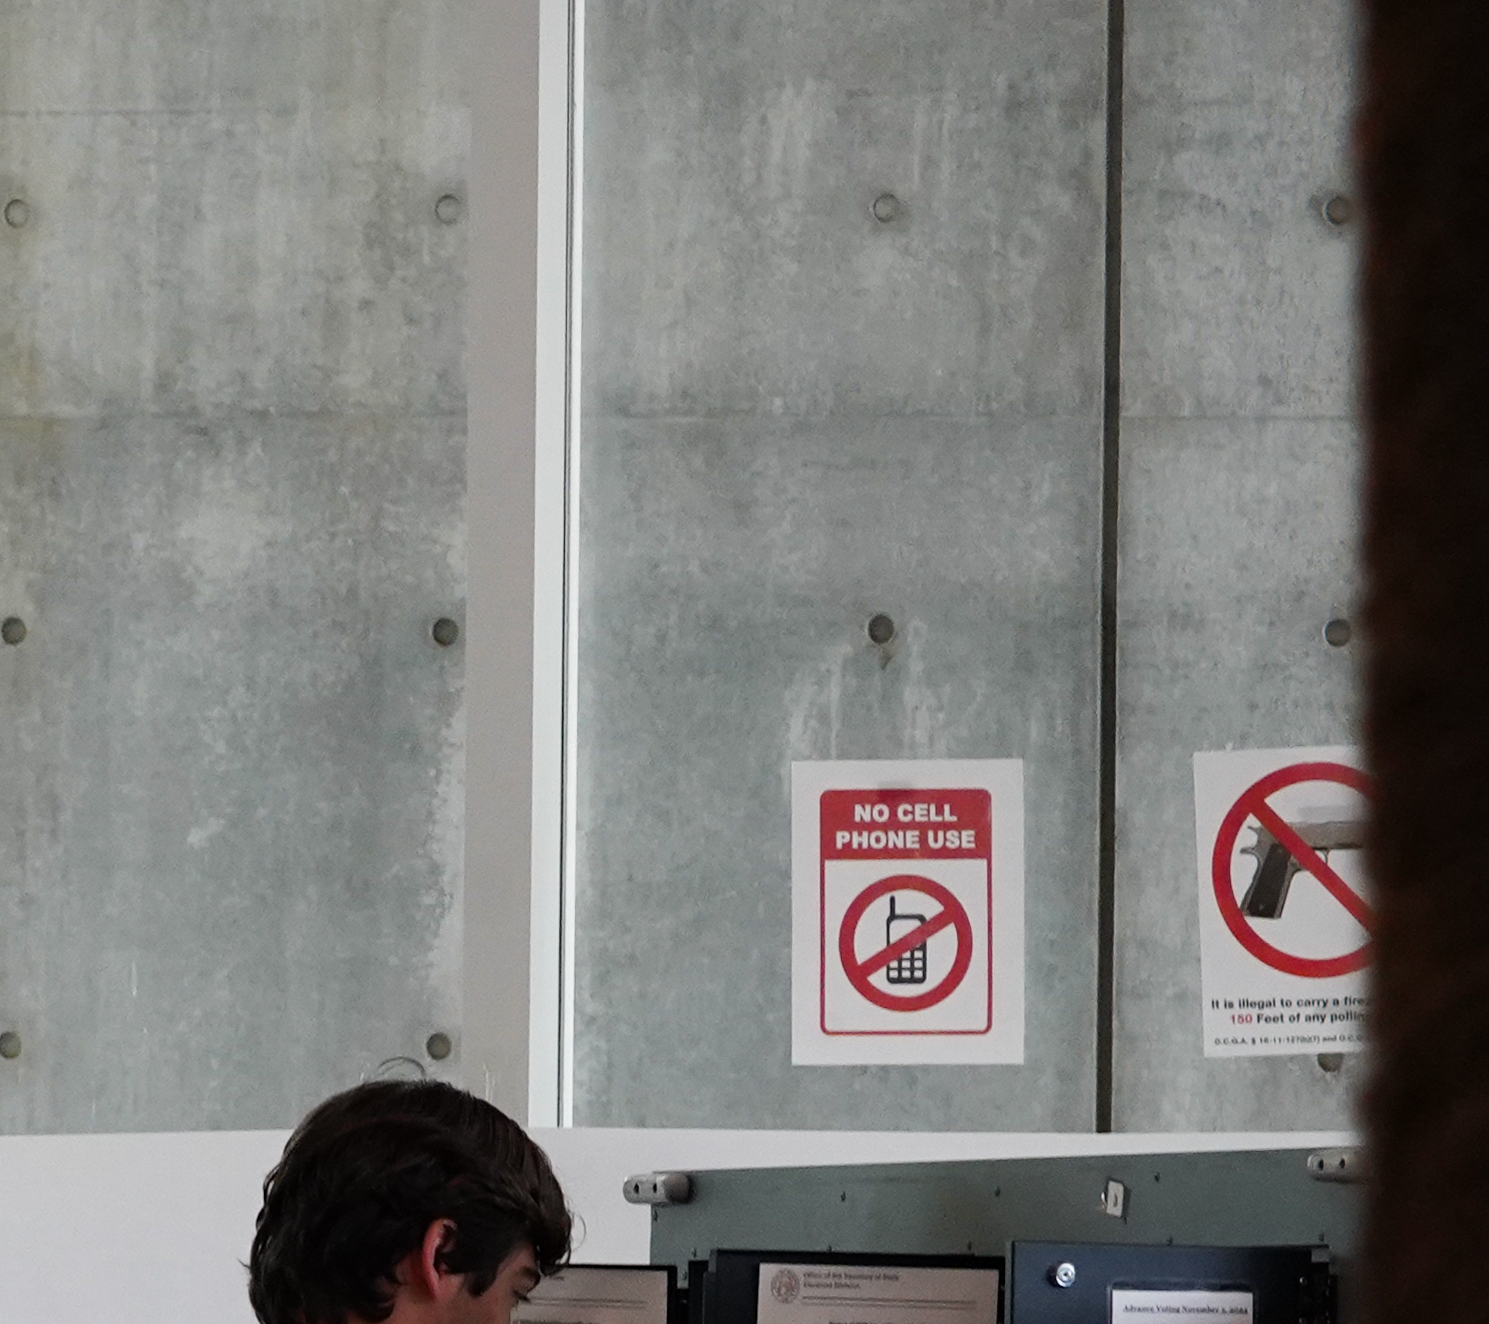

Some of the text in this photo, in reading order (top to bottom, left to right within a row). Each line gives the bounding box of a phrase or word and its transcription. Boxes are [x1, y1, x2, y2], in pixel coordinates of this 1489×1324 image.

[854, 802, 958, 823] NO CELL
[835, 830, 976, 849] PHONE USE
[1211, 999, 1220, 1010] It
[1224, 998, 1234, 1008] is
[1238, 997, 1276, 1010] illegal
[1280, 997, 1292, 1008] to
[1296, 997, 1329, 1009] carry
[1230, 1013, 1253, 1025] 150
[1256, 1013, 1285, 1024] Feet
[1288, 1012, 1301, 1023] of
[1304, 1012, 1326, 1023] any
